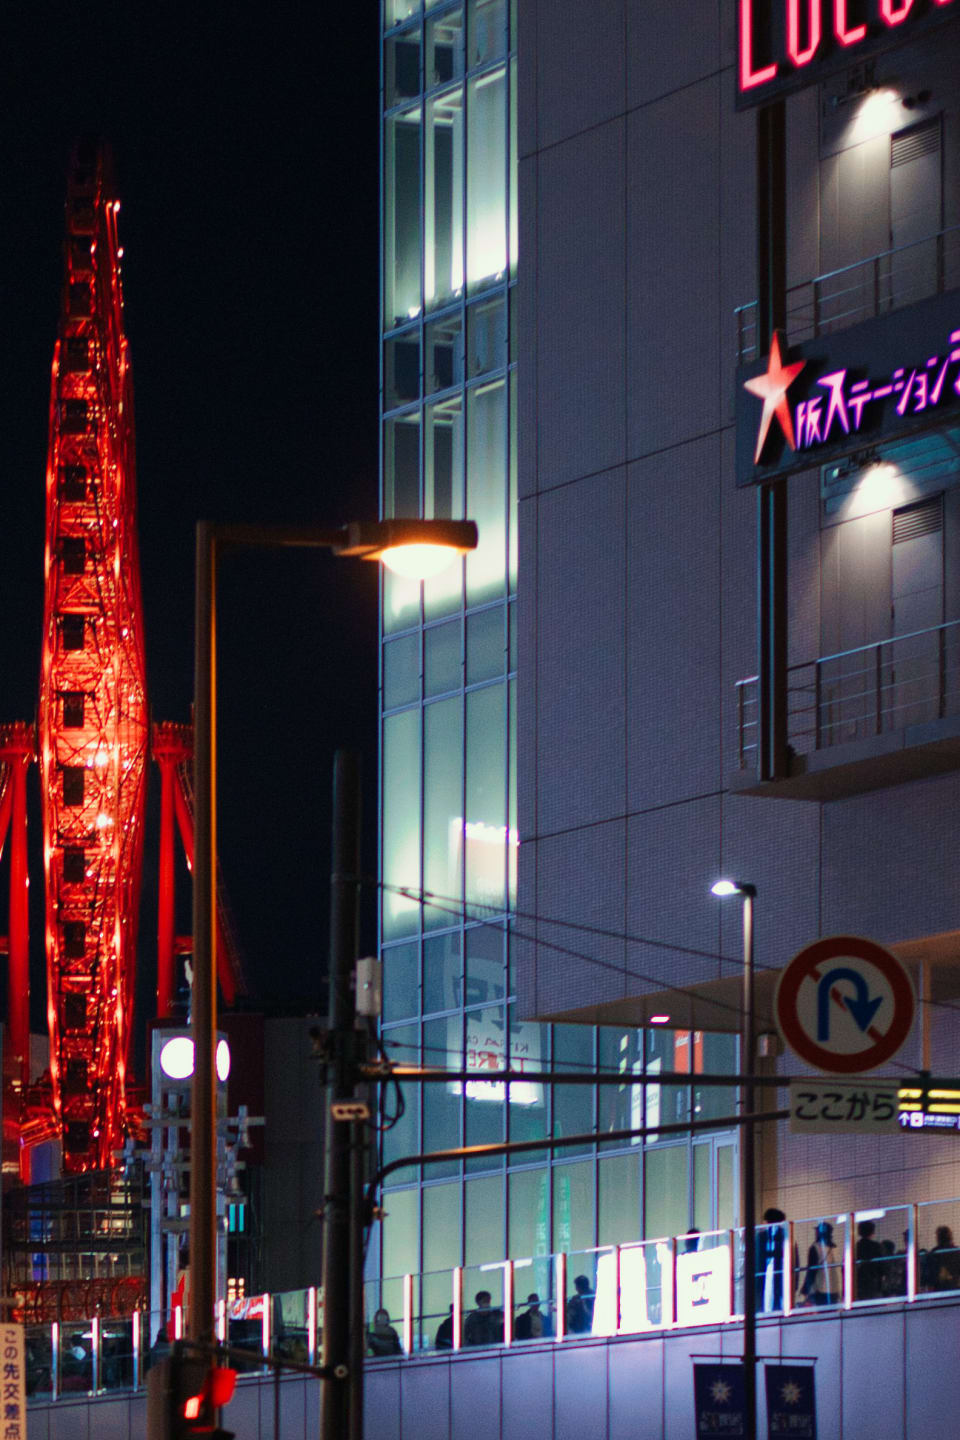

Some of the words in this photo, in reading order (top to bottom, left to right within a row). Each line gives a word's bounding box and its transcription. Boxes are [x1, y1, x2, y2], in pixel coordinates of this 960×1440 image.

[795, 1091, 895, 1121] ここから
[3, 1329, 21, 1440] この先交差点
